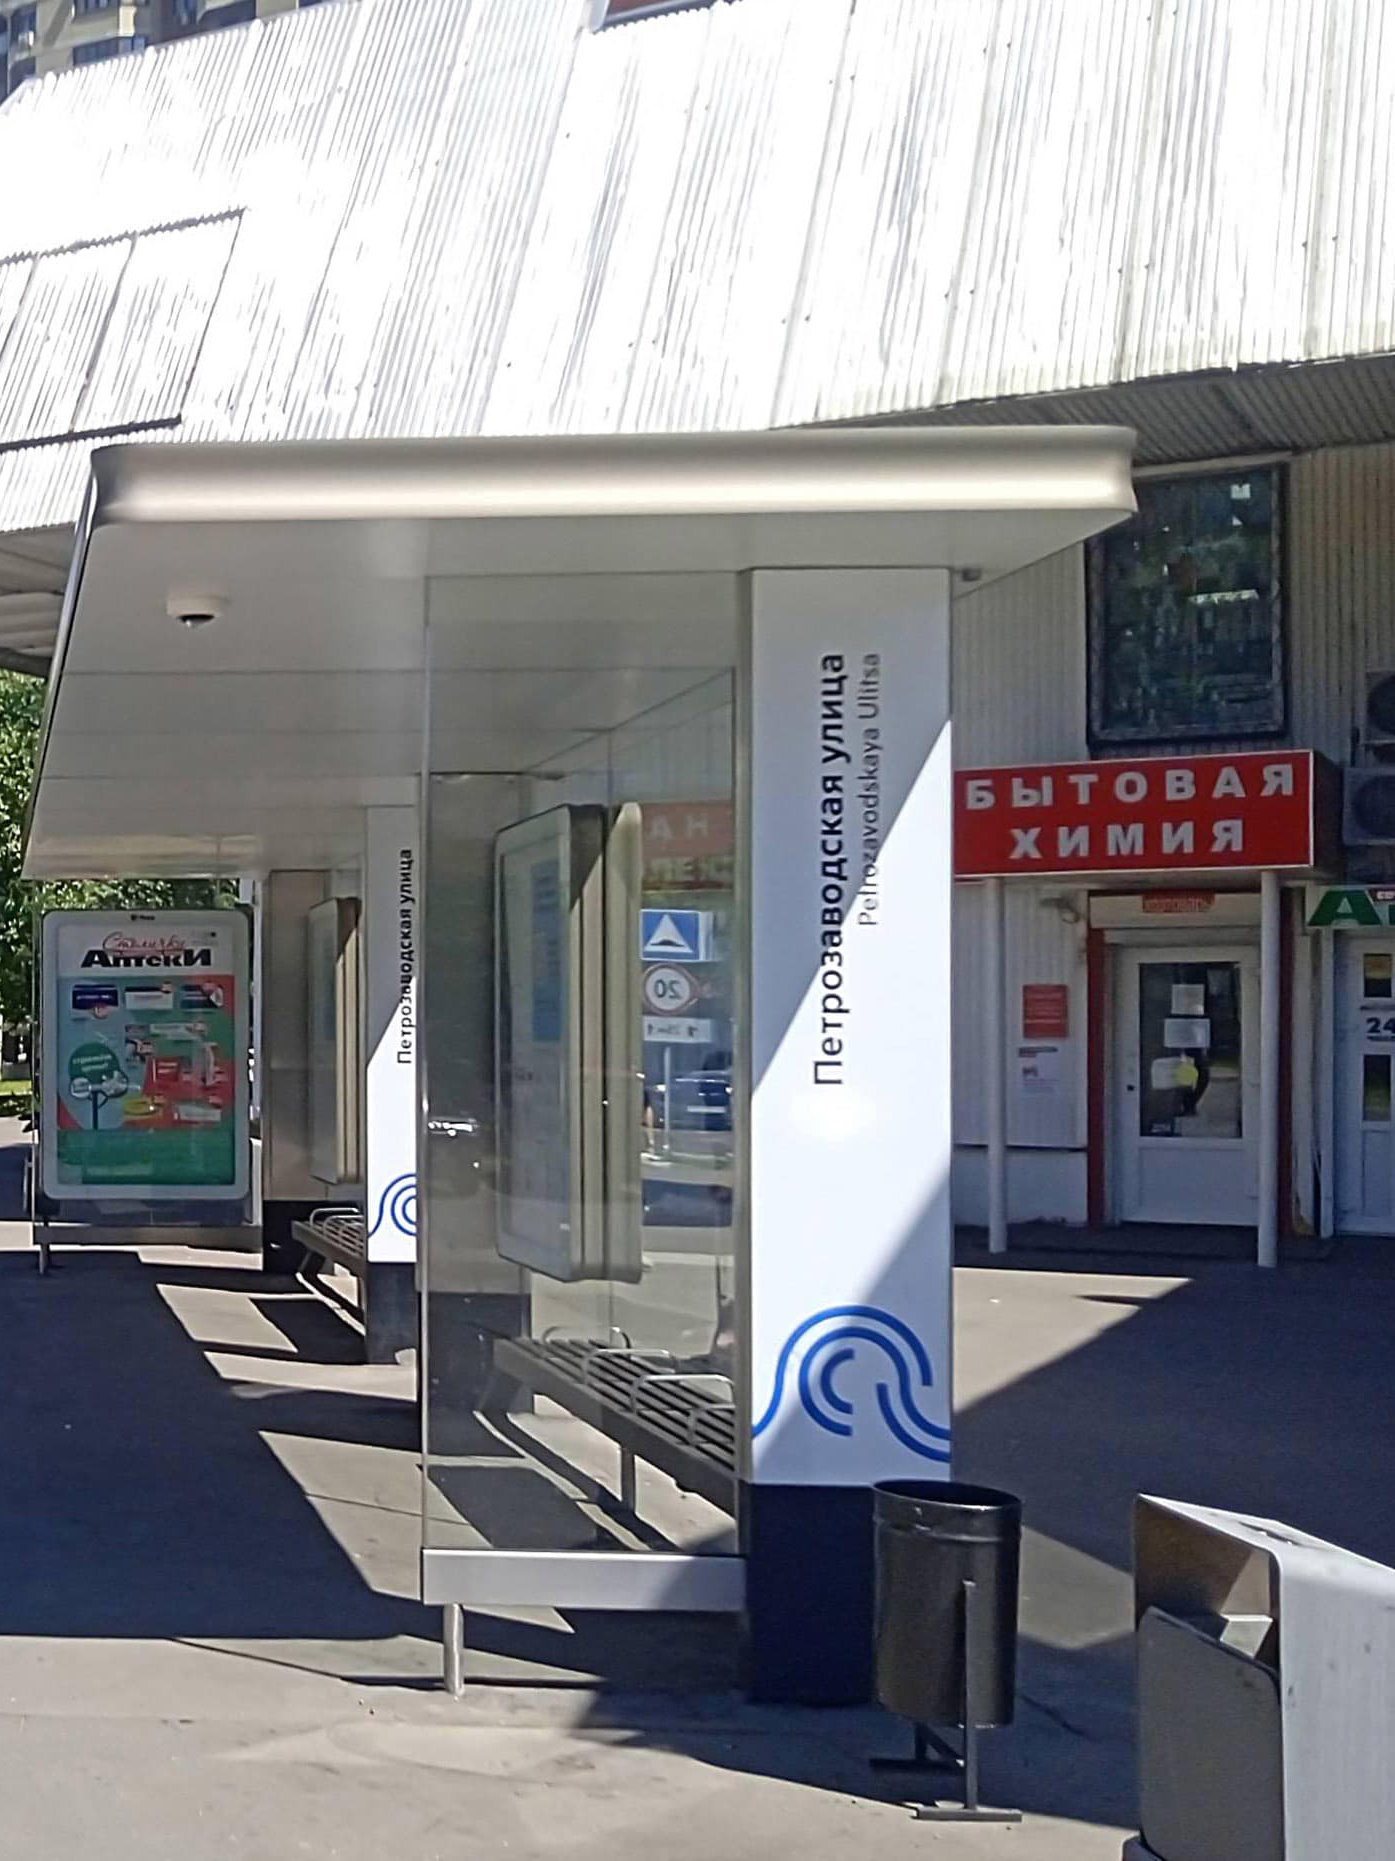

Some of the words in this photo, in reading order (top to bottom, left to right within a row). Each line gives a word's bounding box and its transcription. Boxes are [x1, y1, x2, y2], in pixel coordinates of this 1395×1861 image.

[820, 653, 851, 764] улица
[858, 653, 881, 720] Ulitsa
[857, 727, 883, 927] Petrozavodskaya
[965, 763, 1294, 811] БЫТОВАЯ
[400, 848, 416, 904] улица
[1008, 818, 1244, 860] ХИМИЯ
[814, 774, 850, 1085] Петрозаводская
[397, 908, 416, 1065] Петрозаводская
